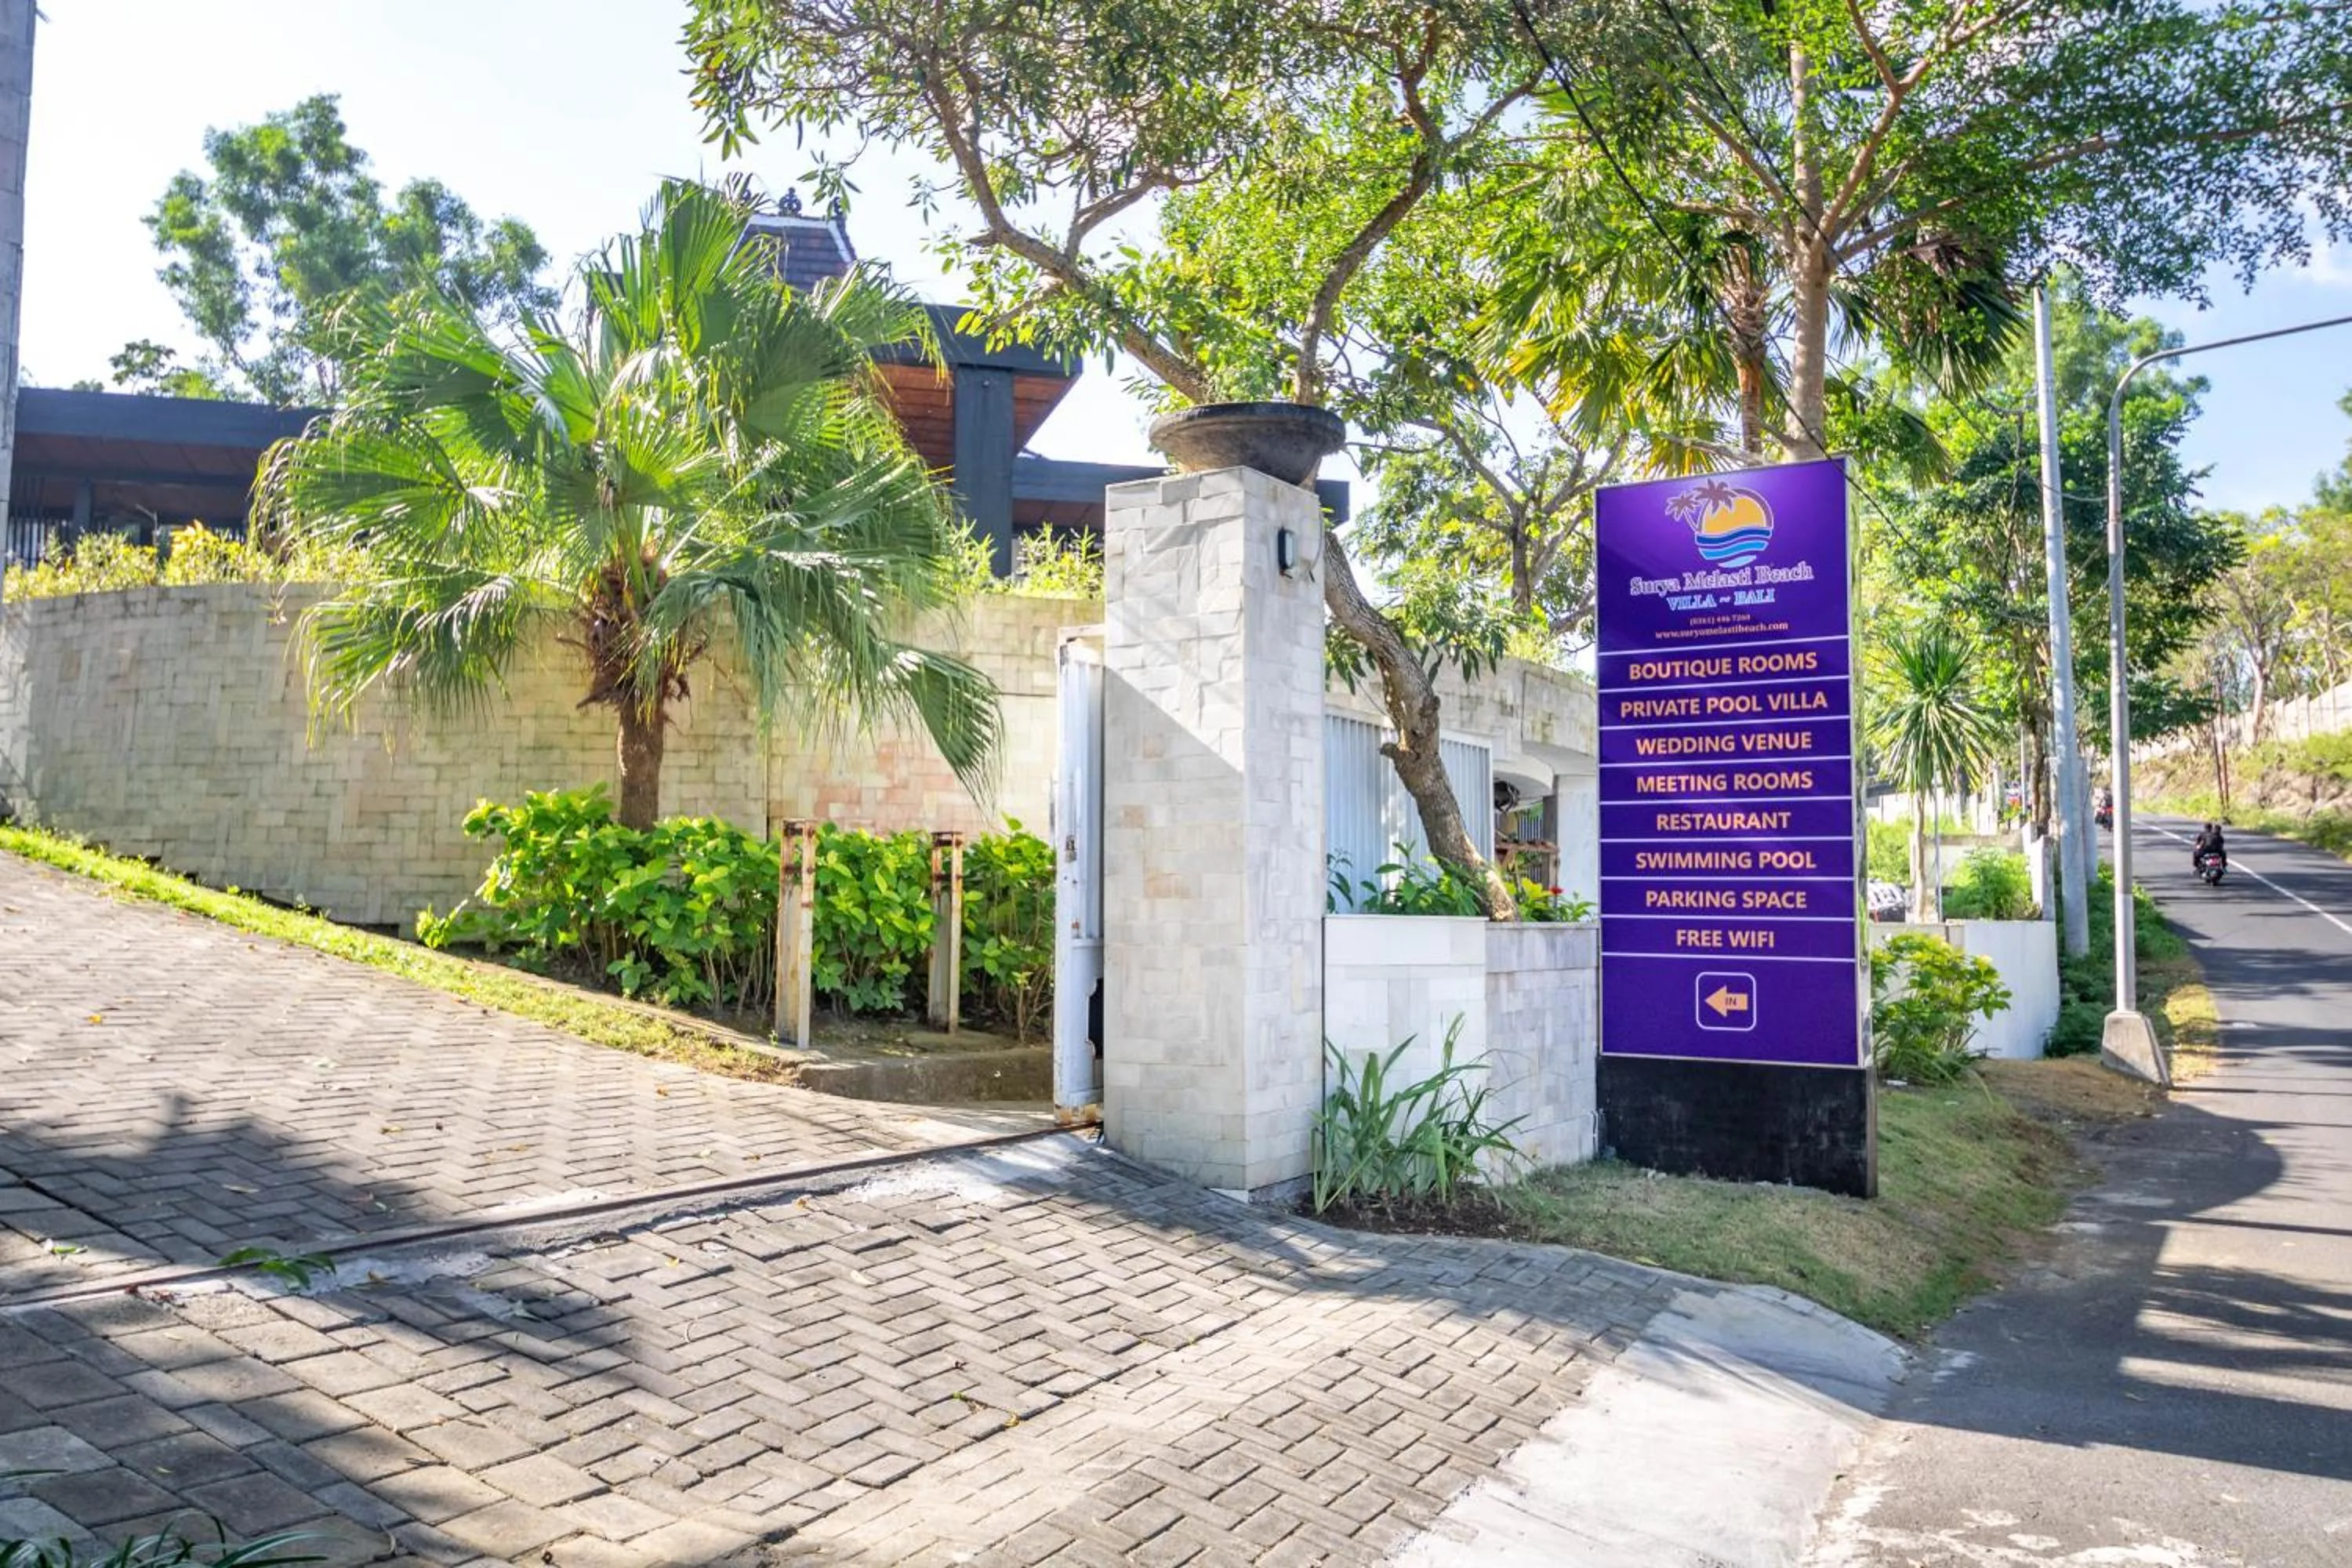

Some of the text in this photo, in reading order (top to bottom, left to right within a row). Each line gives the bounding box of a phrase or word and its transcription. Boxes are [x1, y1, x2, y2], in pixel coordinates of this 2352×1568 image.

[1630, 561, 1813, 596] Surya Melasti Beach
[1667, 594, 1717, 611] VILLA
[1733, 587, 1776, 605] BALI
[1629, 652, 1817, 681] BOUTIQUE ROOMS
[1621, 691, 1828, 718] PRIVATE POOL VILLA
[1635, 731, 1813, 756] WEDDING VENUE
[1635, 771, 1813, 793] MEETING ROOMS
[1656, 811, 1791, 831] RESTAURANT
[1635, 851, 1817, 870] SWIMMING POOL
[1646, 890, 1808, 909] PARKING SPACE
[1675, 929, 1775, 949] FREE WIFI
[1725, 996, 1737, 1007] IN
